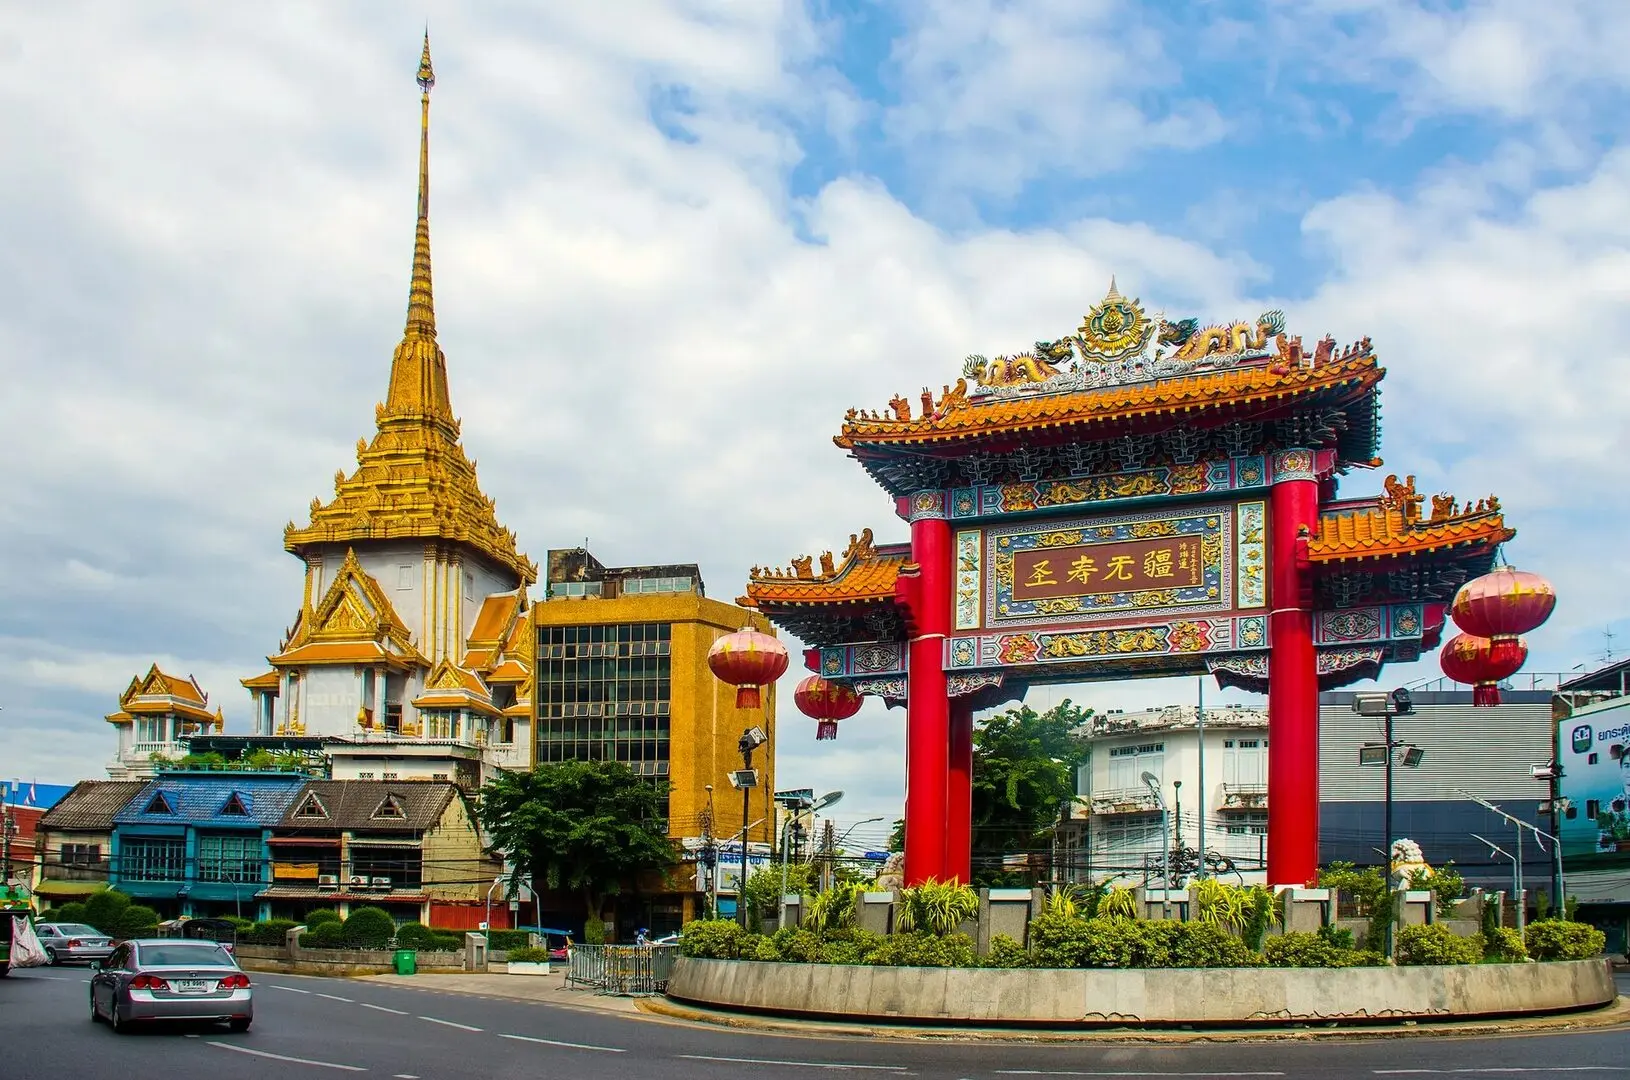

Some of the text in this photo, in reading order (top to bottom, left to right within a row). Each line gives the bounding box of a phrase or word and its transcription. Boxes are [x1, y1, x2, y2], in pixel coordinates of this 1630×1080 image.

[1024, 549, 1175, 588] 圣寿无疆
[1598, 723, 1630, 741] ยกระดั
